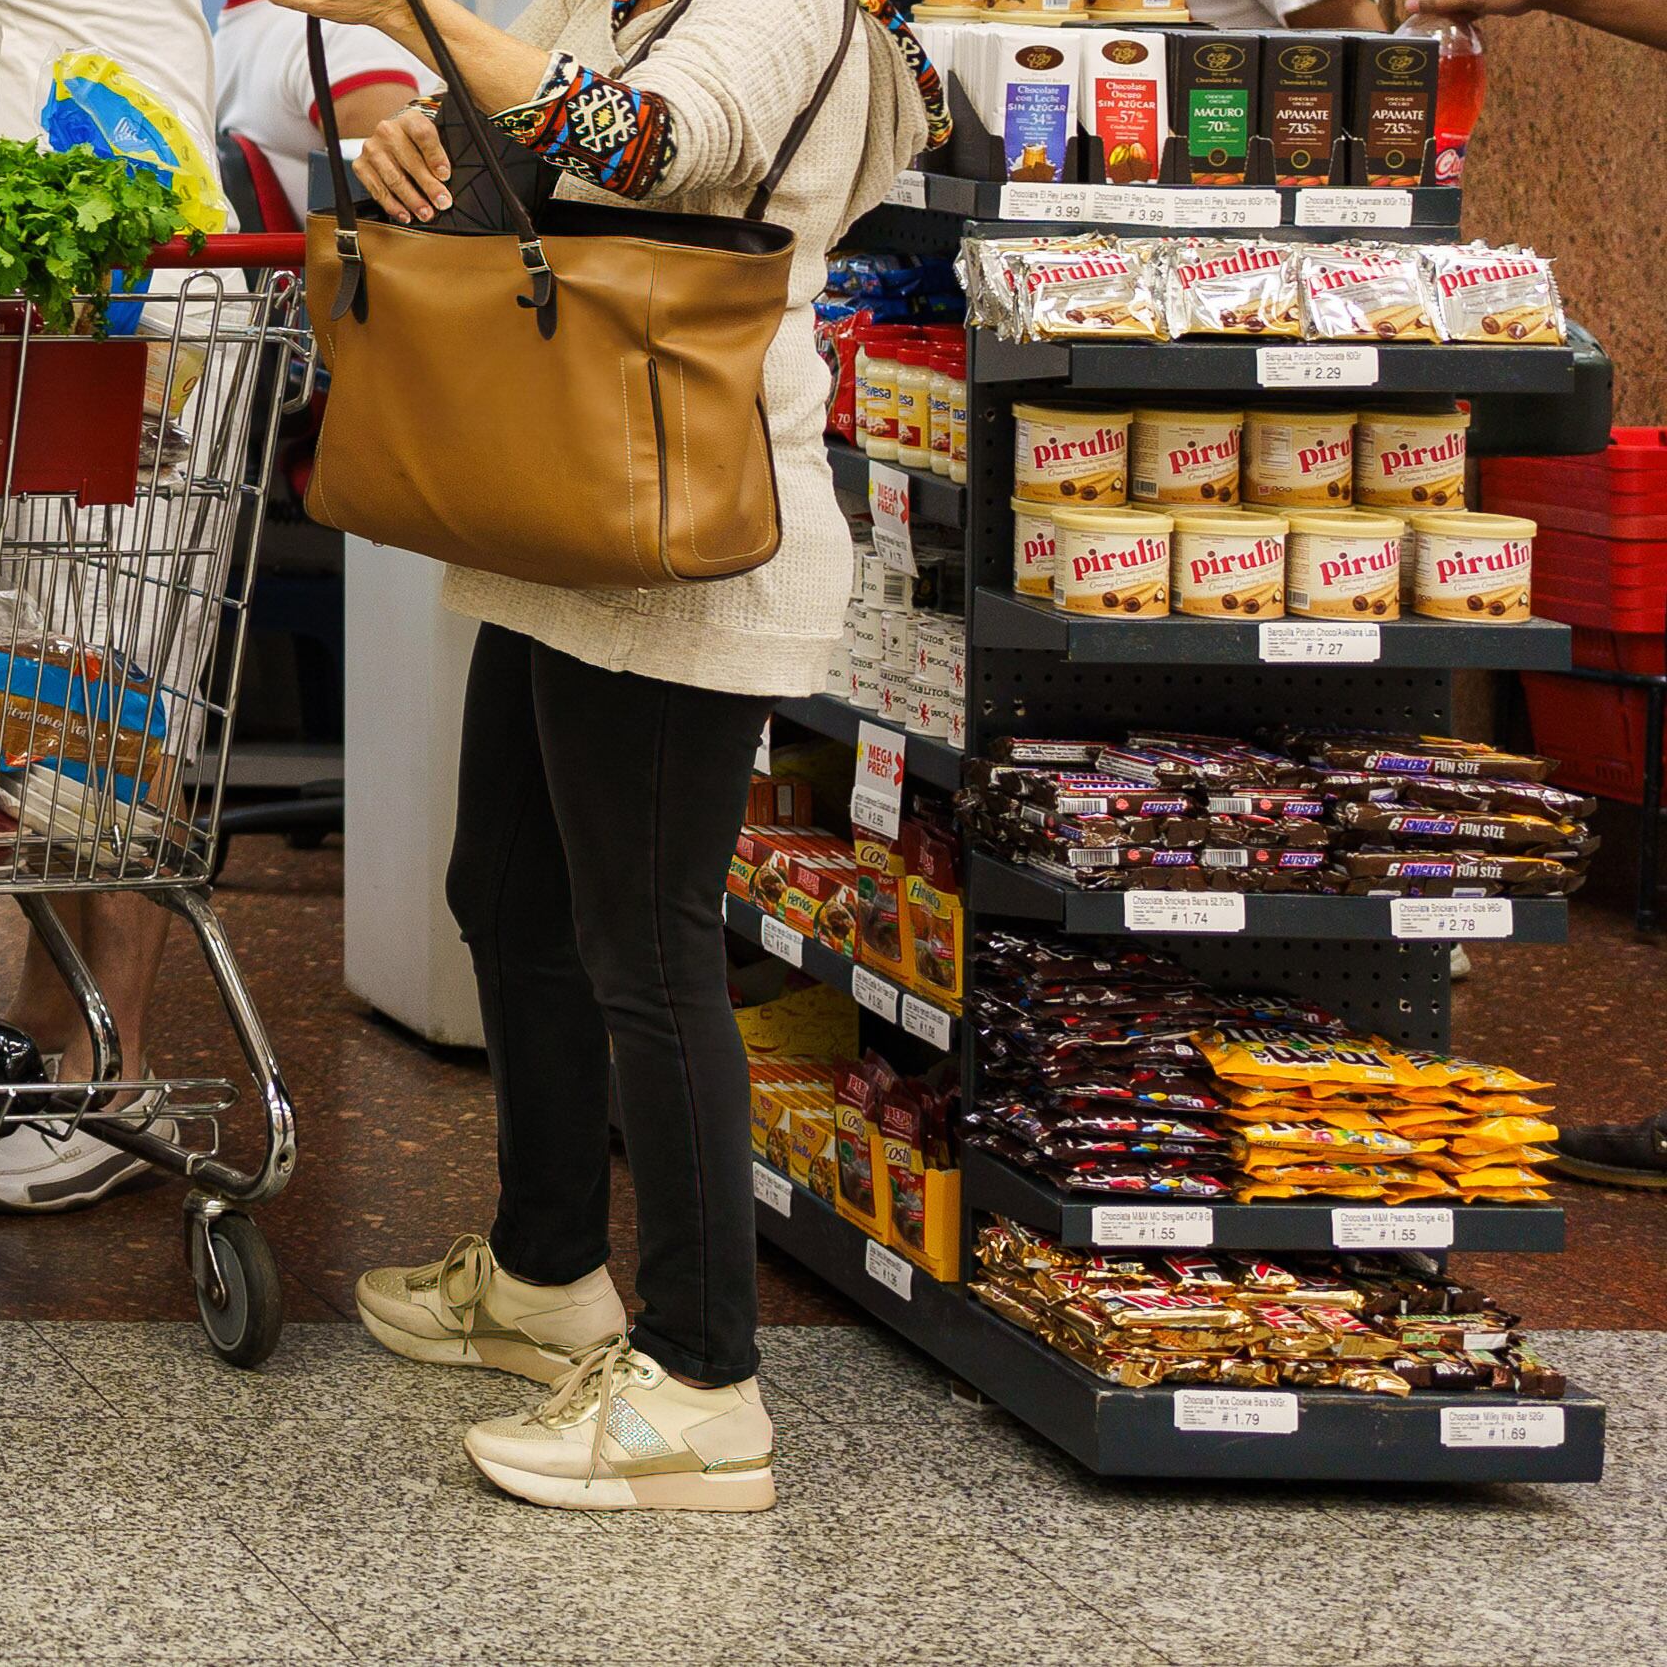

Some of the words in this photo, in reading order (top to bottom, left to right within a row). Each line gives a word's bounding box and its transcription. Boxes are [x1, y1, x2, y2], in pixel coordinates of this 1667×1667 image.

[1017, 85, 1060, 95] Chocolate
[1105, 81, 1147, 92] Chocolate
[1015, 94, 1032, 102] con
[1034, 94, 1060, 103] Leche
[1111, 90, 1142, 100] Oscuro
[1007, 103, 1025, 112] SIN
[1028, 102, 1067, 112] AZÚCAR
[1098, 100, 1116, 109] SIN
[1117, 99, 1156, 109] AZÚCAR
[1194, 107, 1244, 118] MACURO
[1276, 109, 1329, 121] APAMATE
[1372, 108, 1425, 121] APAMATE
[1055, 206, 1080, 218] 3.99
[1138, 210, 1164, 222] 3.99
[1221, 211, 1246, 224] 3.79
[1350, 211, 1376, 224] 3.79
[1027, 254, 1124, 295] pirulin
[1179, 246, 1283, 290] pirulin
[1305, 257, 1404, 300] pirulin
[1439, 256, 1538, 299] pirulin
[1315, 367, 1341, 380] 2.29
[1033, 426, 1126, 469] pirulin
[1380, 431, 1466, 476] pirulin
[1072, 538, 1167, 582] pirulin
[1190, 539, 1284, 584] pirulin
[1435, 541, 1531, 586] pirulin
[1317, 643, 1343, 656] 7.27
[868, 743, 893, 766] MEGA
[1378, 756, 1433, 772] SNICKERS
[1434, 759, 1455, 773] FUN
[1457, 760, 1480, 775] SIZE
[1401, 819, 1456, 834] SNICKERS
[1458, 823, 1478, 837] FUN
[1480, 824, 1505, 839] SIZE
[1400, 863, 1453, 877] SNICKERS
[1456, 864, 1476, 878] FUN
[1478, 865, 1503, 879] SIZE
[1183, 912, 1208, 925] 1.74
[1449, 919, 1476, 932] 2.78
[1100, 1212, 1131, 1221] Chocolate
[1150, 1227, 1176, 1241] 1.55
[1390, 1228, 1416, 1242] 1.55
[1234, 1413, 1260, 1426] 1.79
[1500, 1427, 1526, 1441] 1.69
